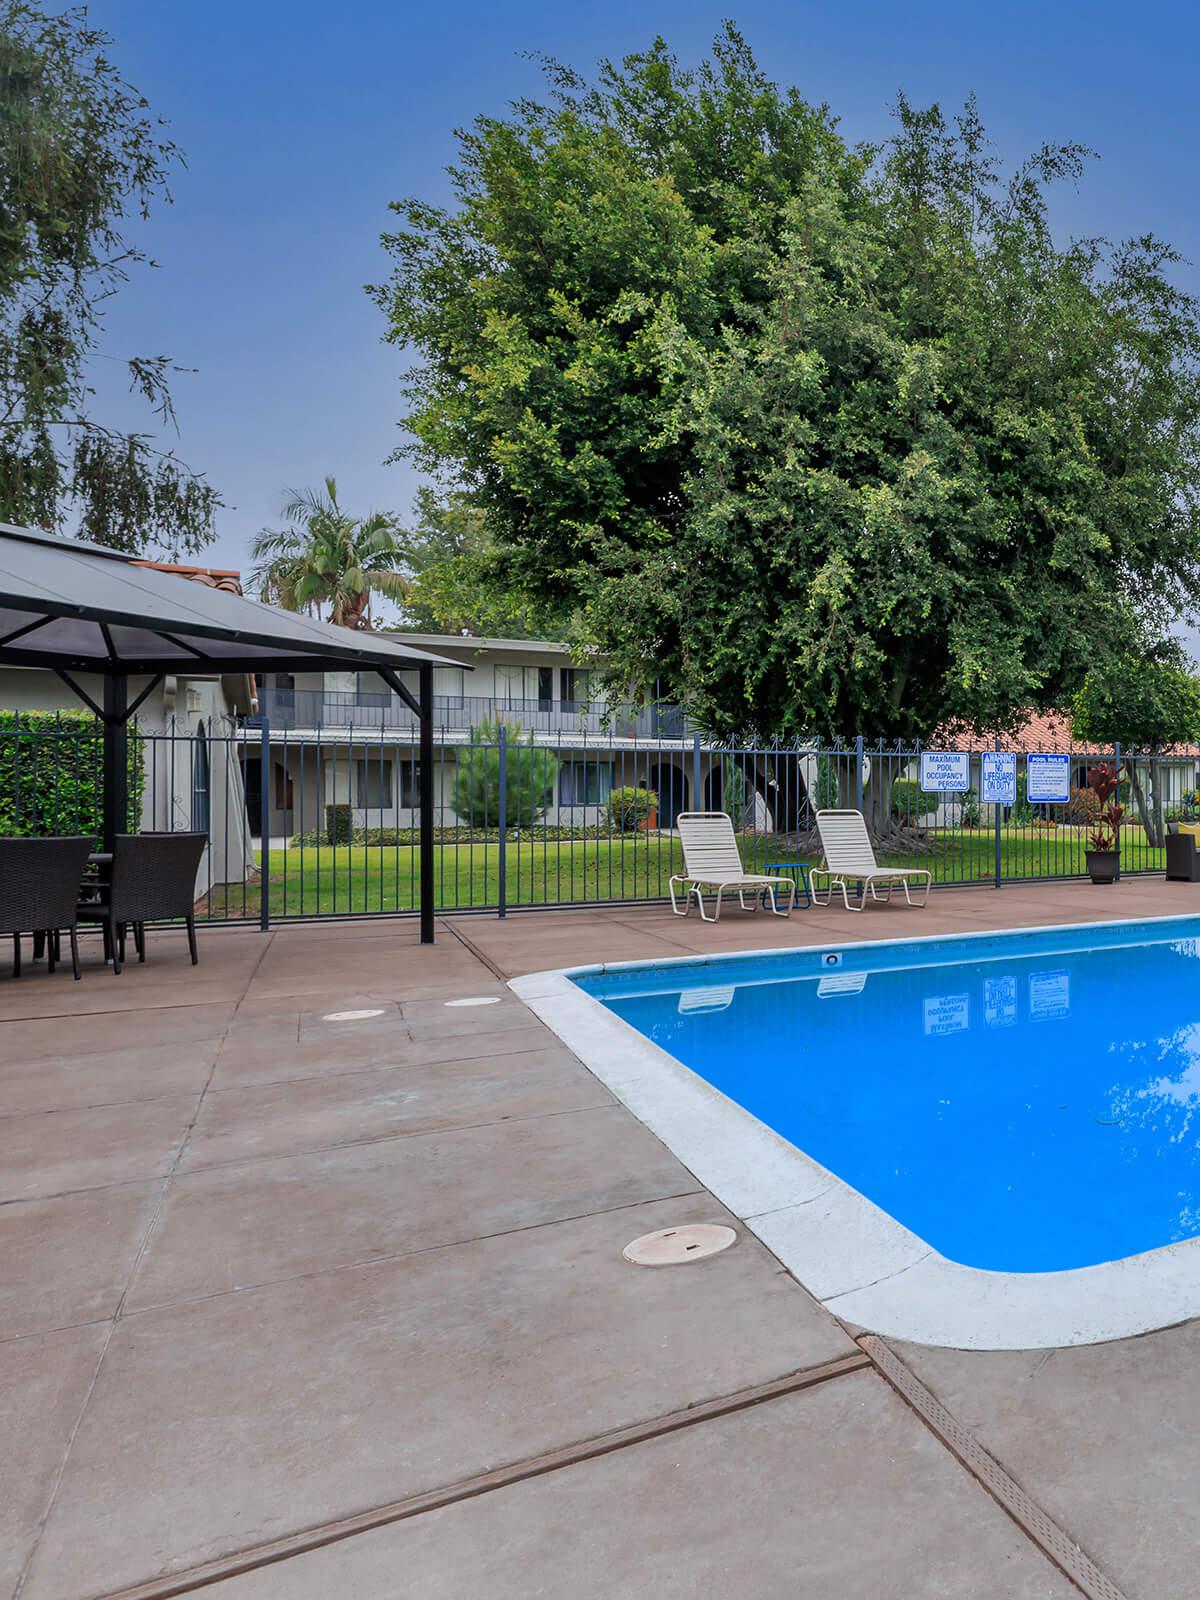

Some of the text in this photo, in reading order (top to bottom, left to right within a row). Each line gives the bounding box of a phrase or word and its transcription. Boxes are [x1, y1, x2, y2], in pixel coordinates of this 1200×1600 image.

[995, 763, 1003, 772] NO
[984, 772, 1014, 780] LIFEGUARD
[938, 780, 967, 788] PERSONS
[987, 781, 1010, 790] ON DUTY
